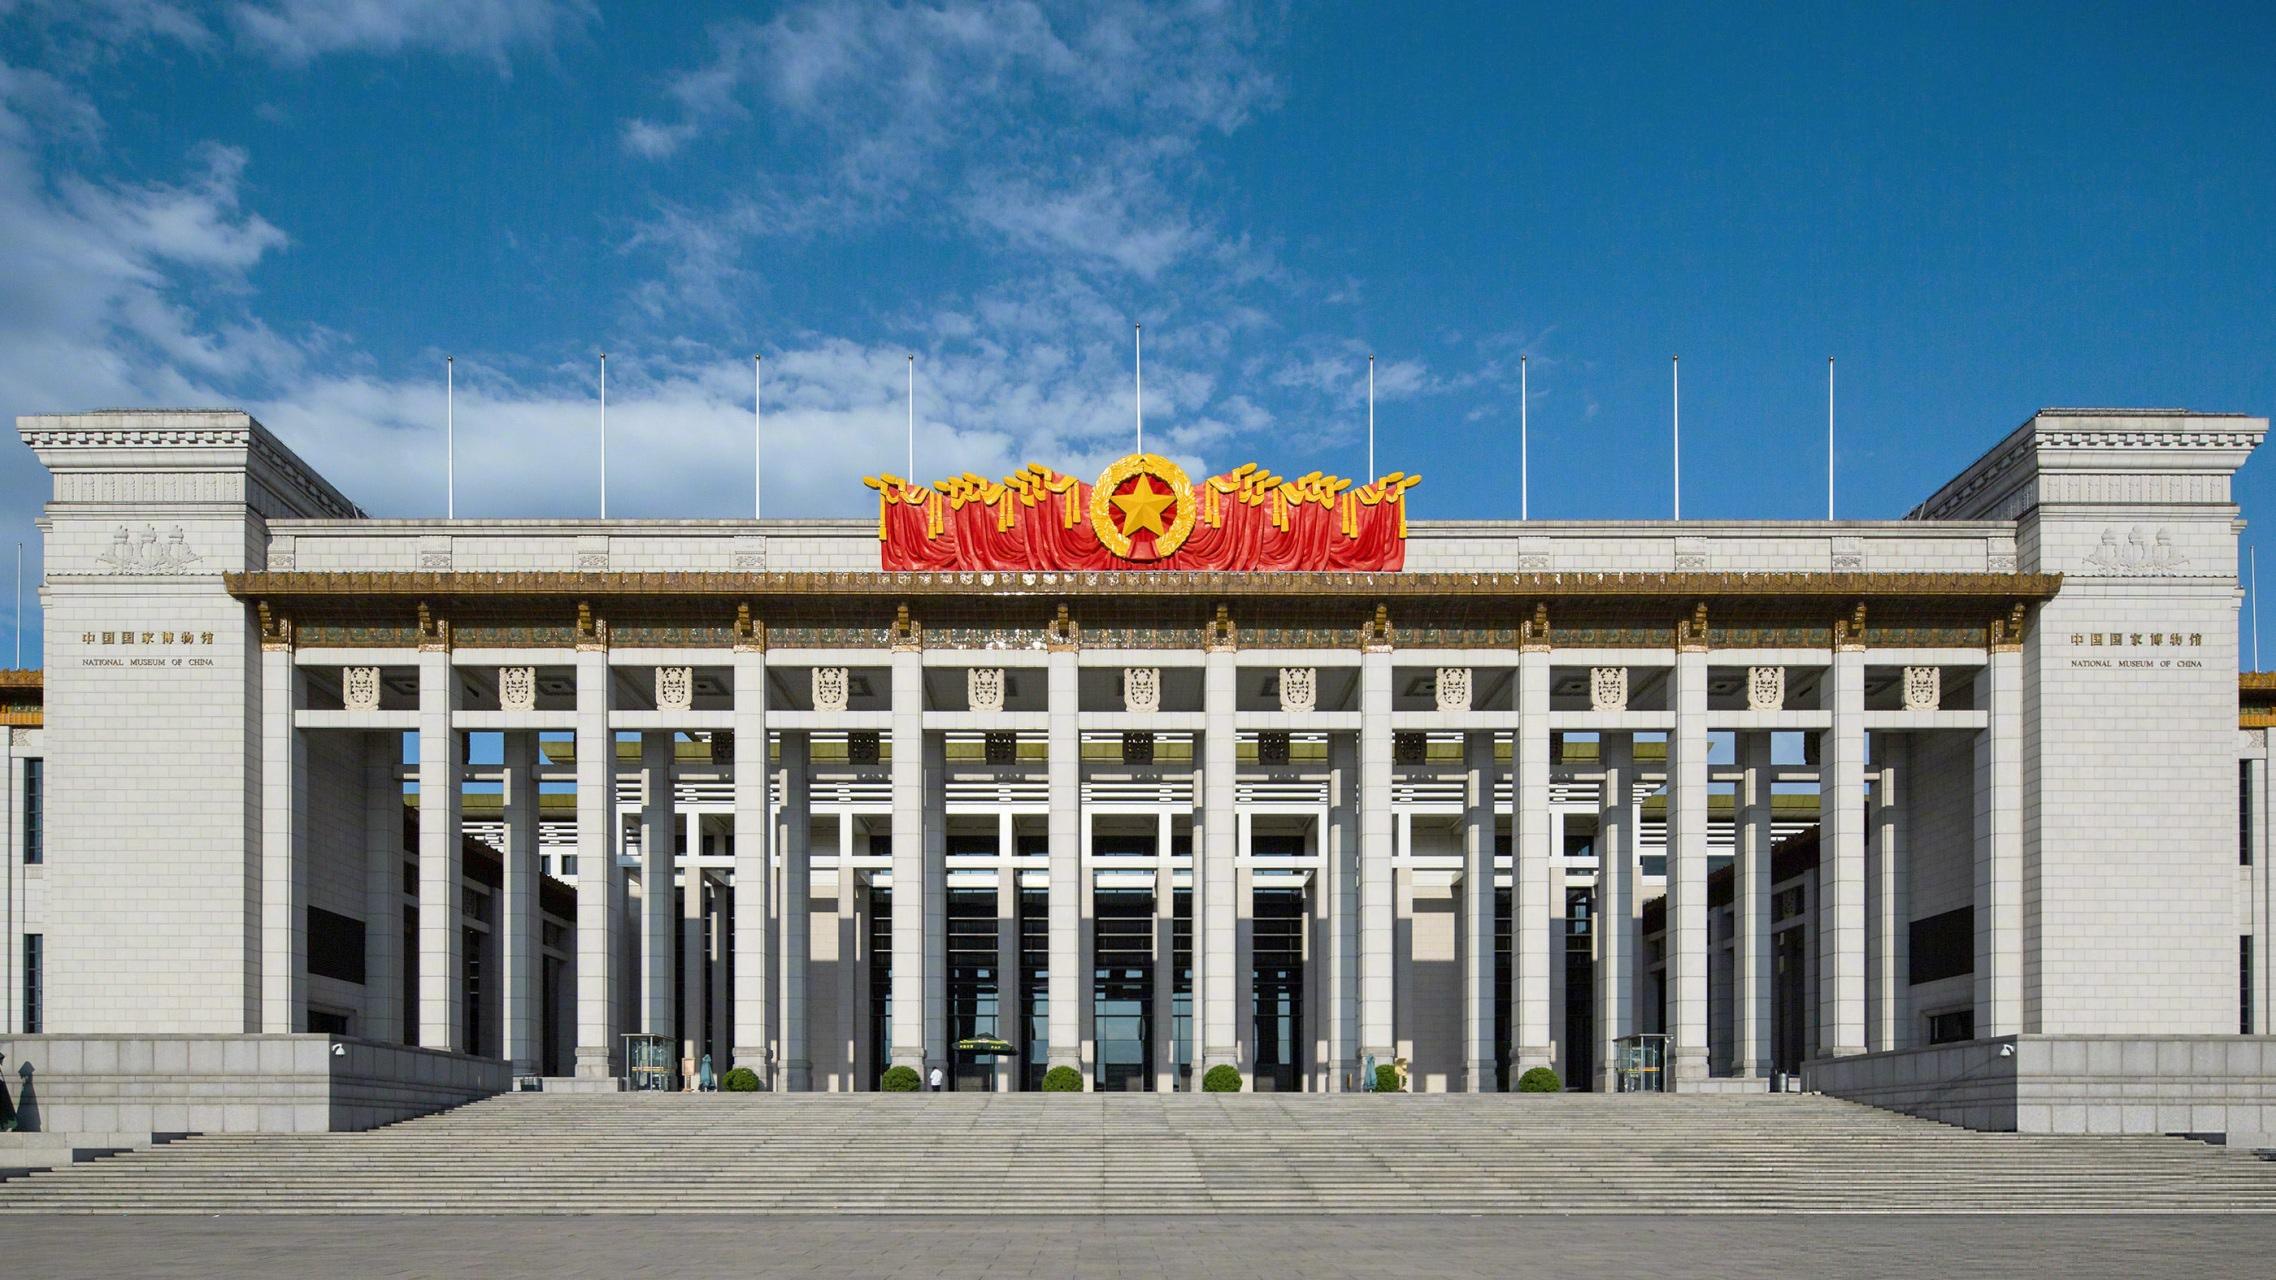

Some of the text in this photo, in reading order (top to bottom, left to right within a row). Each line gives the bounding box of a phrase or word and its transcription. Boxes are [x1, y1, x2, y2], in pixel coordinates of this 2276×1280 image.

[82, 631, 214, 645] 中国国家博物馆
[2070, 632, 2202, 646] 中国国家博物馆
[82, 658, 214, 666] NATIONAL MUSEUM OF CHINA
[2071, 660, 2202, 668] NATIONAL MUSEUM OF CHINA
